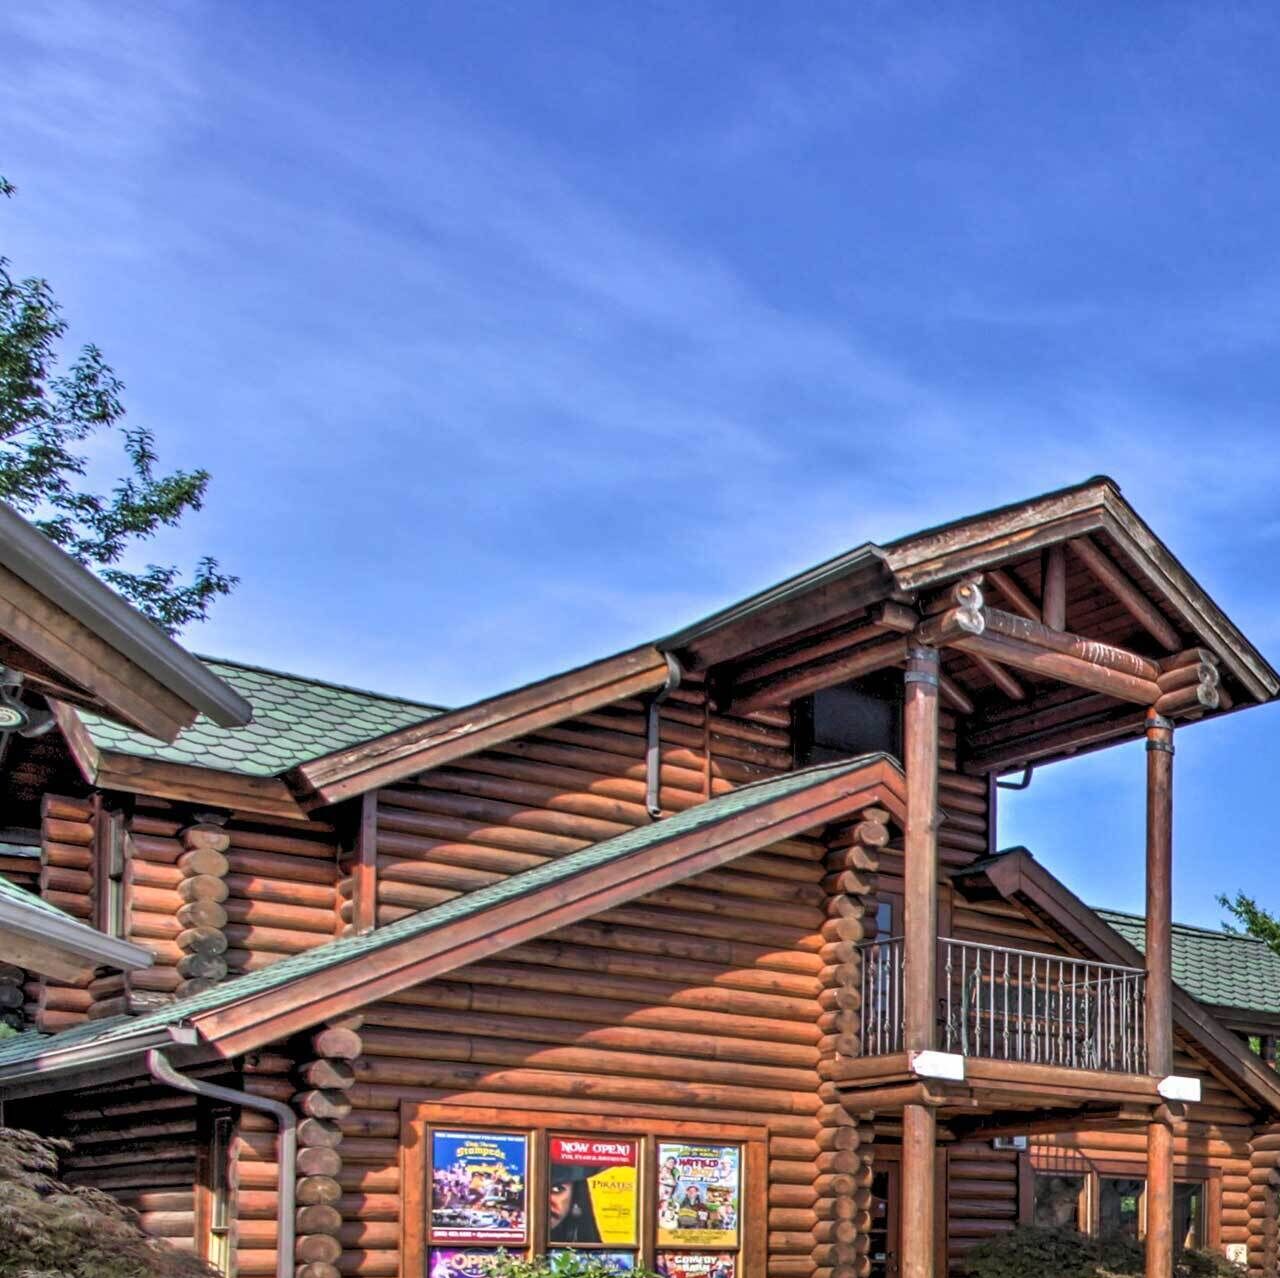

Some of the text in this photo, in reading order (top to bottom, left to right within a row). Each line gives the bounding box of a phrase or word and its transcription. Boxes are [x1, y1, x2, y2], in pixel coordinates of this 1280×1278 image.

[561, 1141, 630, 1156] NOW OPEN!
[592, 1180, 633, 1190] PIRATES
[674, 1255, 718, 1264] COMEDY
